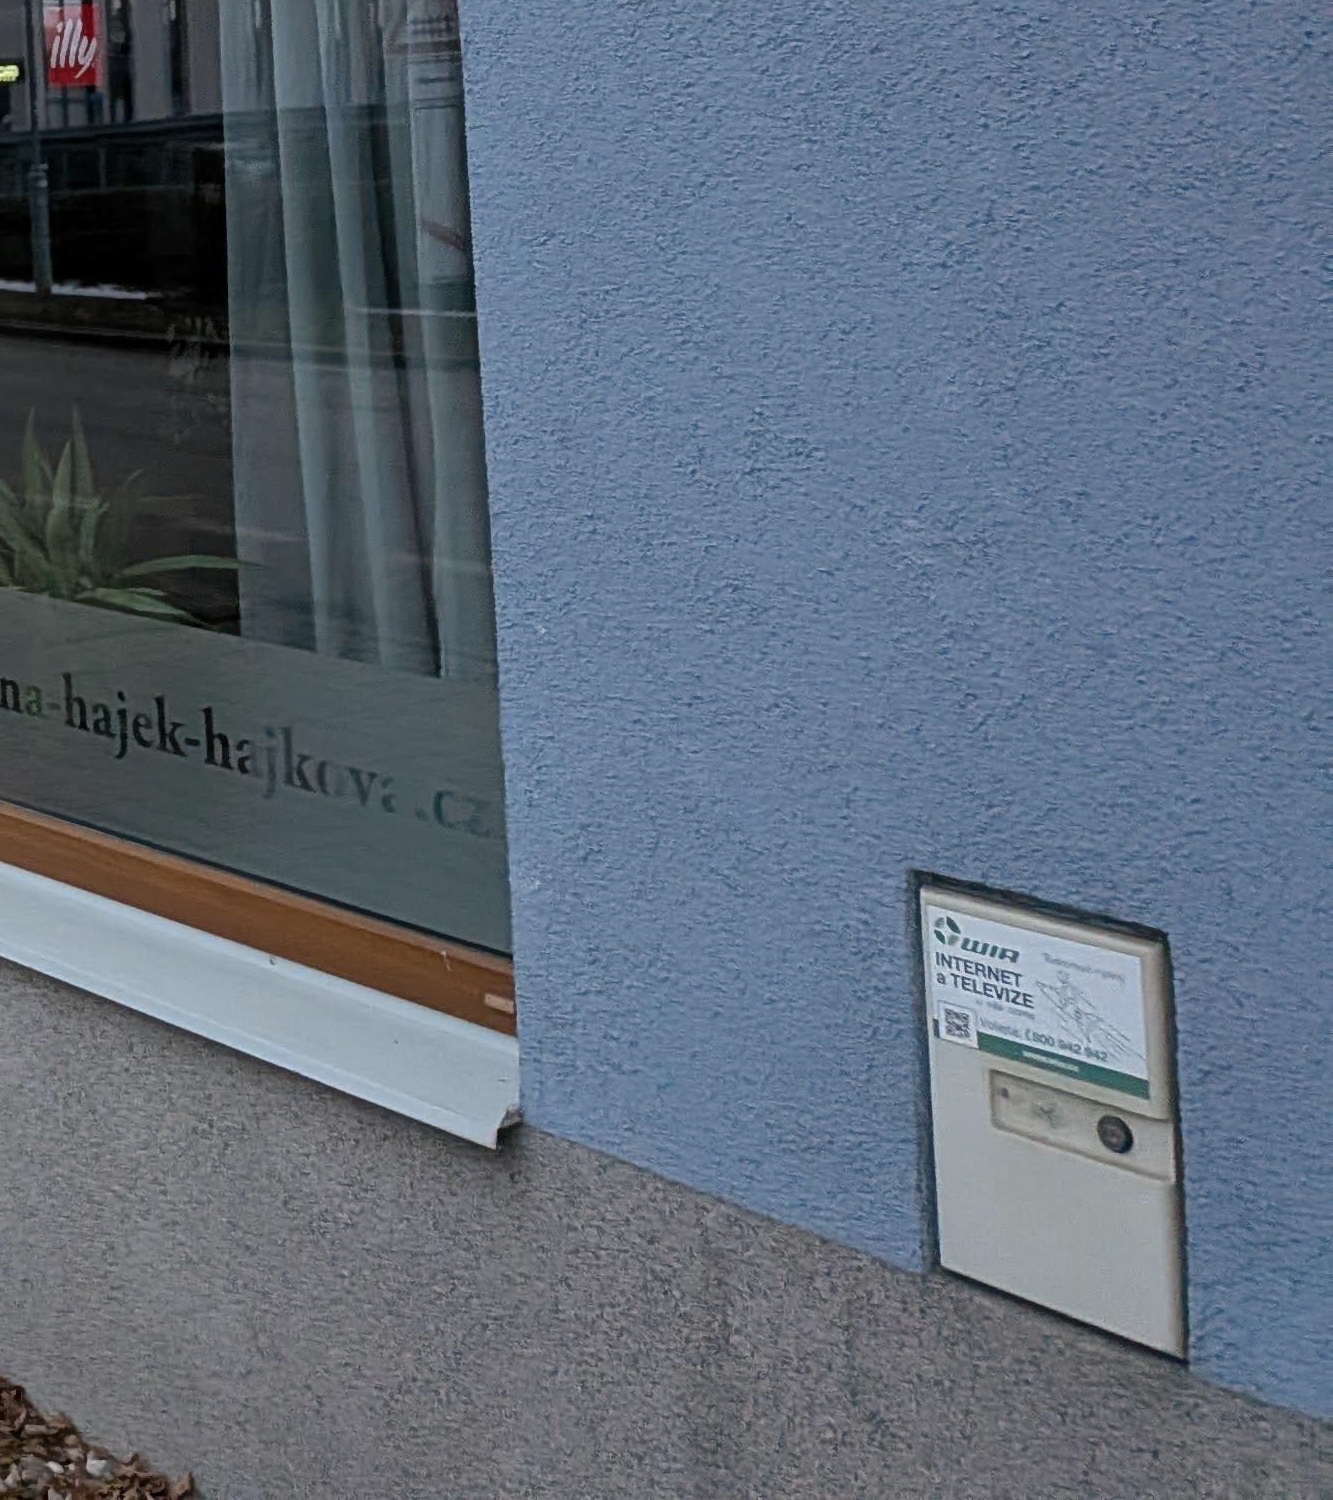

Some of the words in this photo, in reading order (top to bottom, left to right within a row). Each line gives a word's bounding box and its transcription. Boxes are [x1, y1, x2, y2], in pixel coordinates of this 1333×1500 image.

[50, 18, 98, 79] illy
[935, 951, 1023, 988] INTERNET
[936, 972, 946, 985] a
[950, 971, 1035, 1009] TELEVIZE
